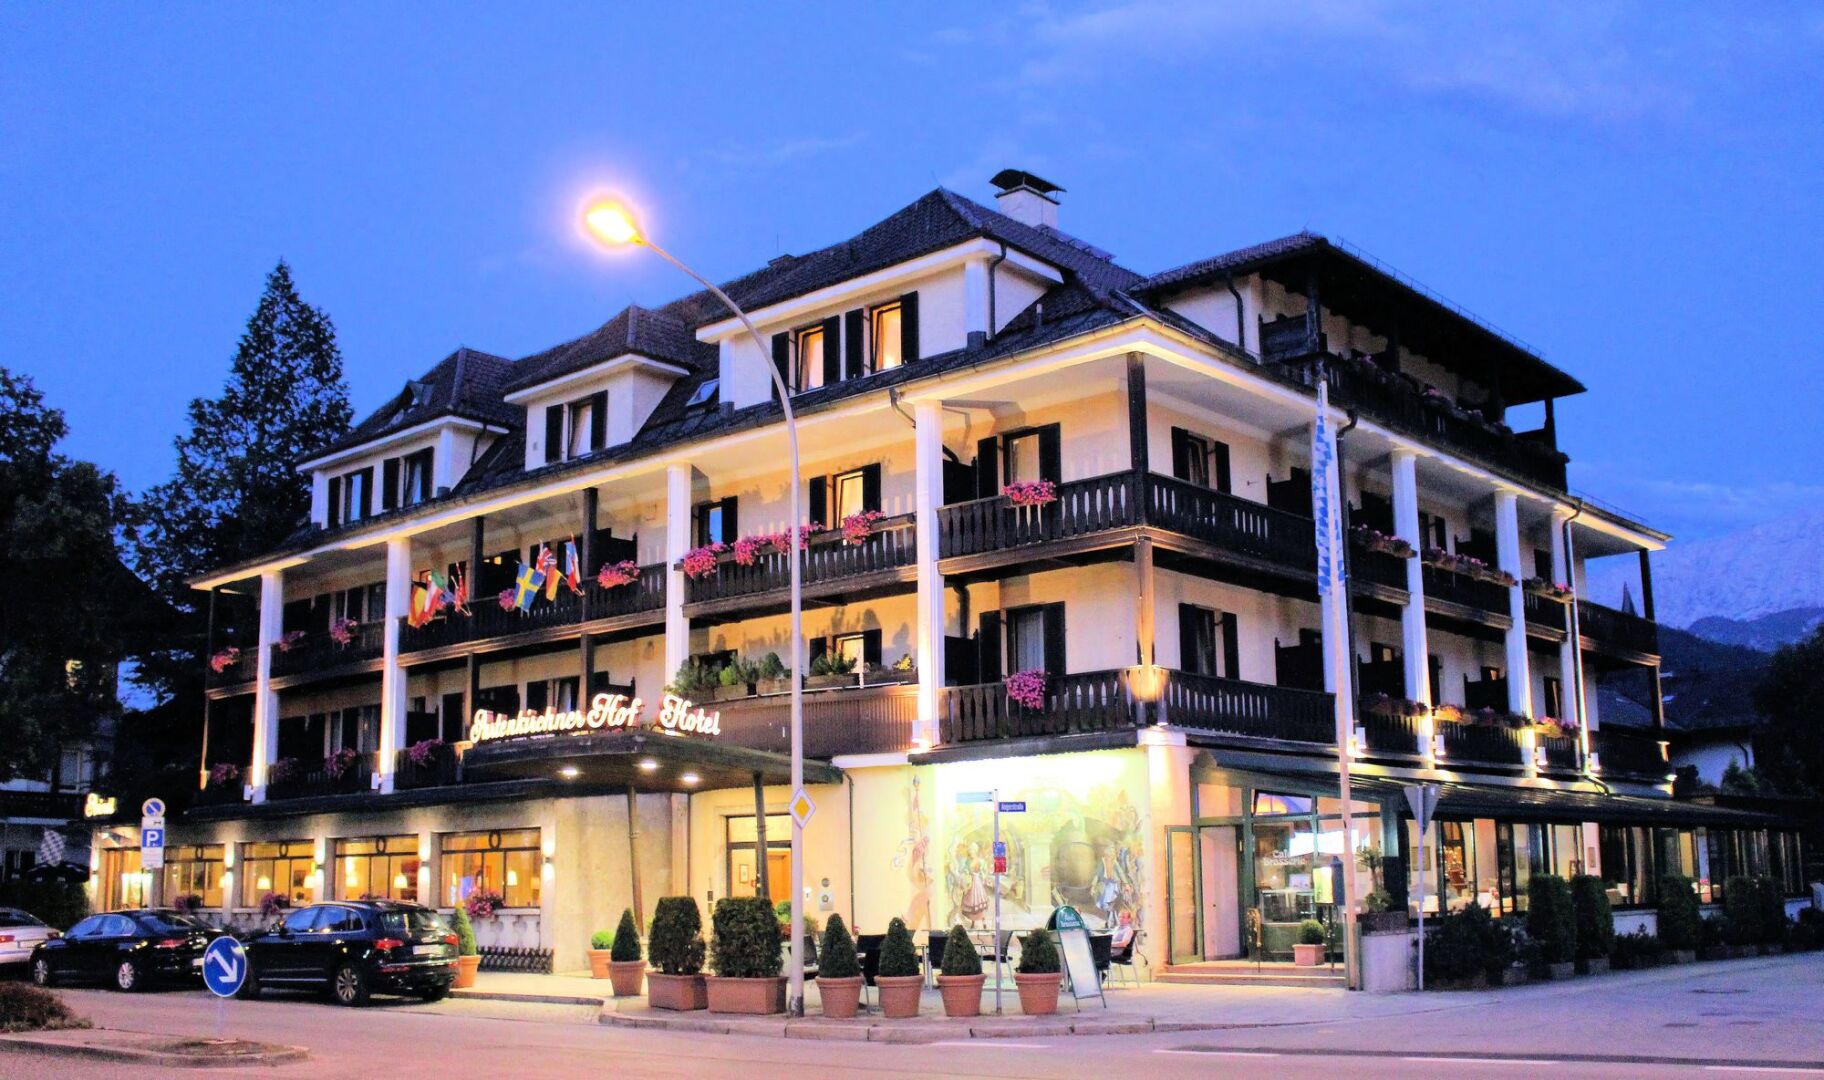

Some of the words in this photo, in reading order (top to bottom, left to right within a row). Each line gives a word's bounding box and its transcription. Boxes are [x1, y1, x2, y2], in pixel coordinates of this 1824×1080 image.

[587, 693, 642, 728] Hof
[660, 694, 720, 735] Hotel
[146, 830, 159, 847] P
